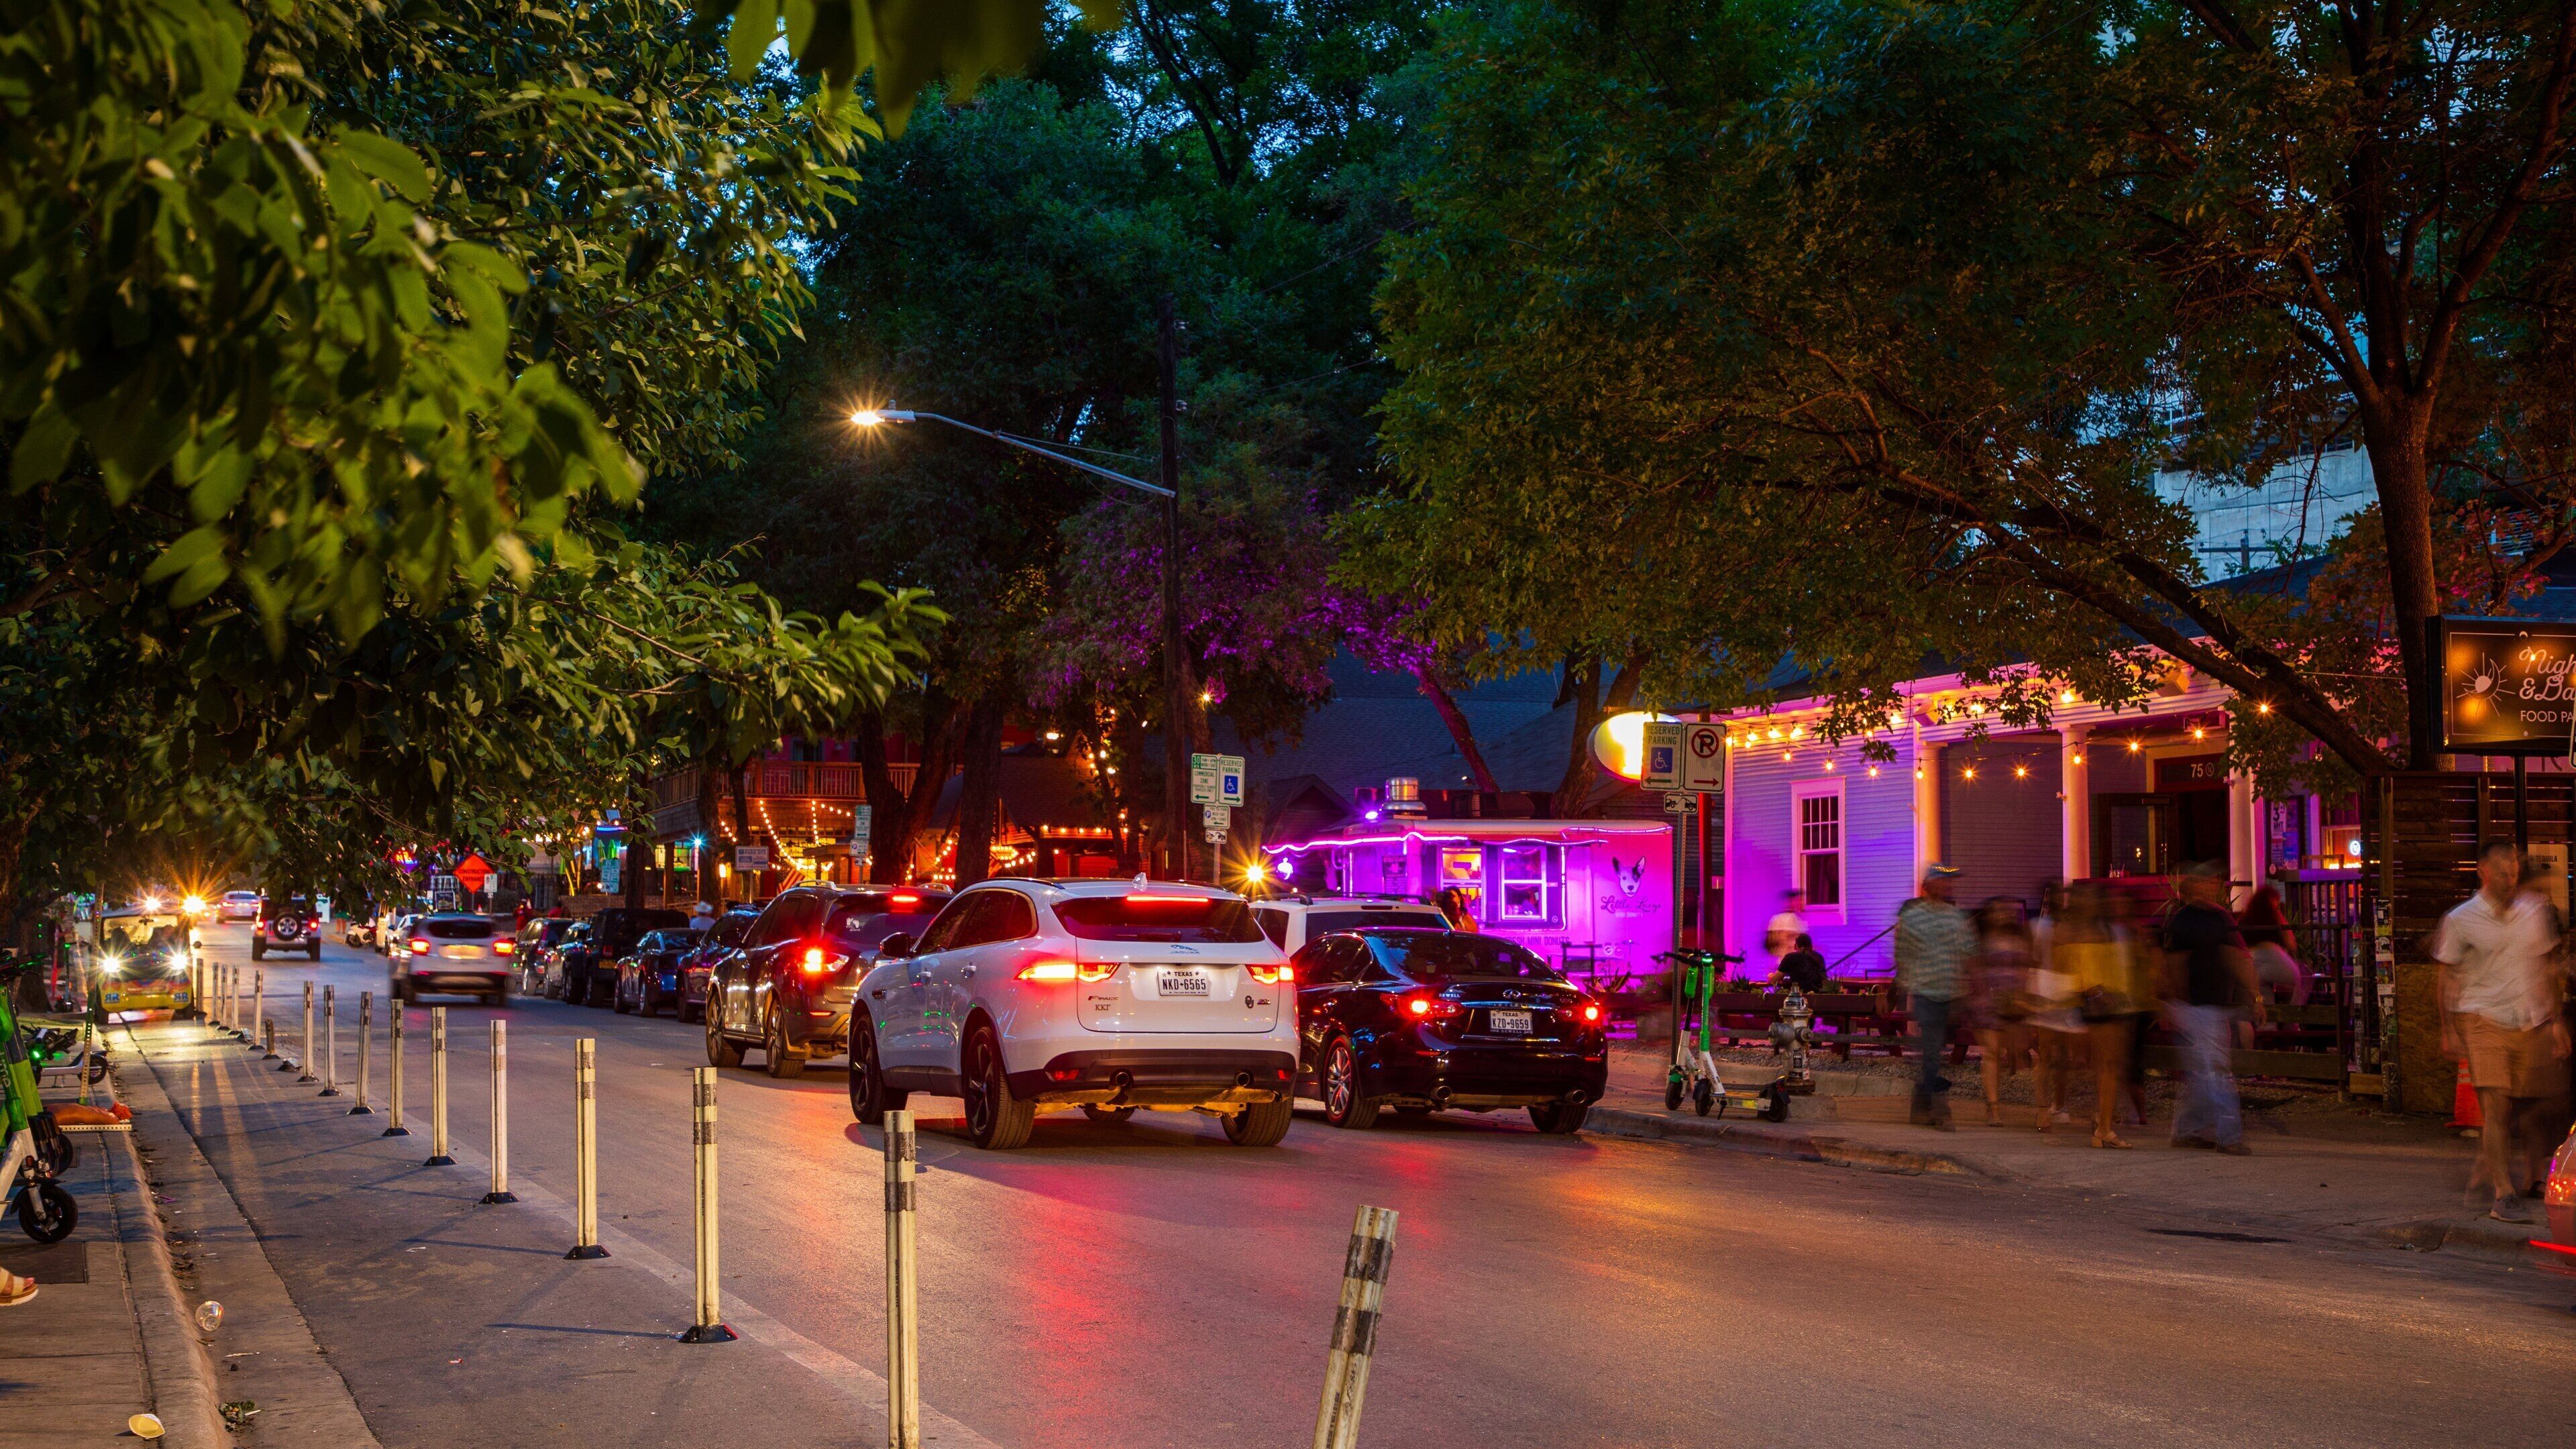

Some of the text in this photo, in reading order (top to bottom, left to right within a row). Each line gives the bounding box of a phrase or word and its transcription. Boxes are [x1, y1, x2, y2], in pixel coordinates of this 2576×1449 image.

[2519, 646, 2576, 682] Nigh
[2520, 710, 2557, 722] FOOD
[1647, 726, 1680, 735] RESERVED
[1648, 736, 1677, 745] PARKING
[1221, 759, 1242, 767] RESERVED
[2191, 763, 2203, 777] 75
